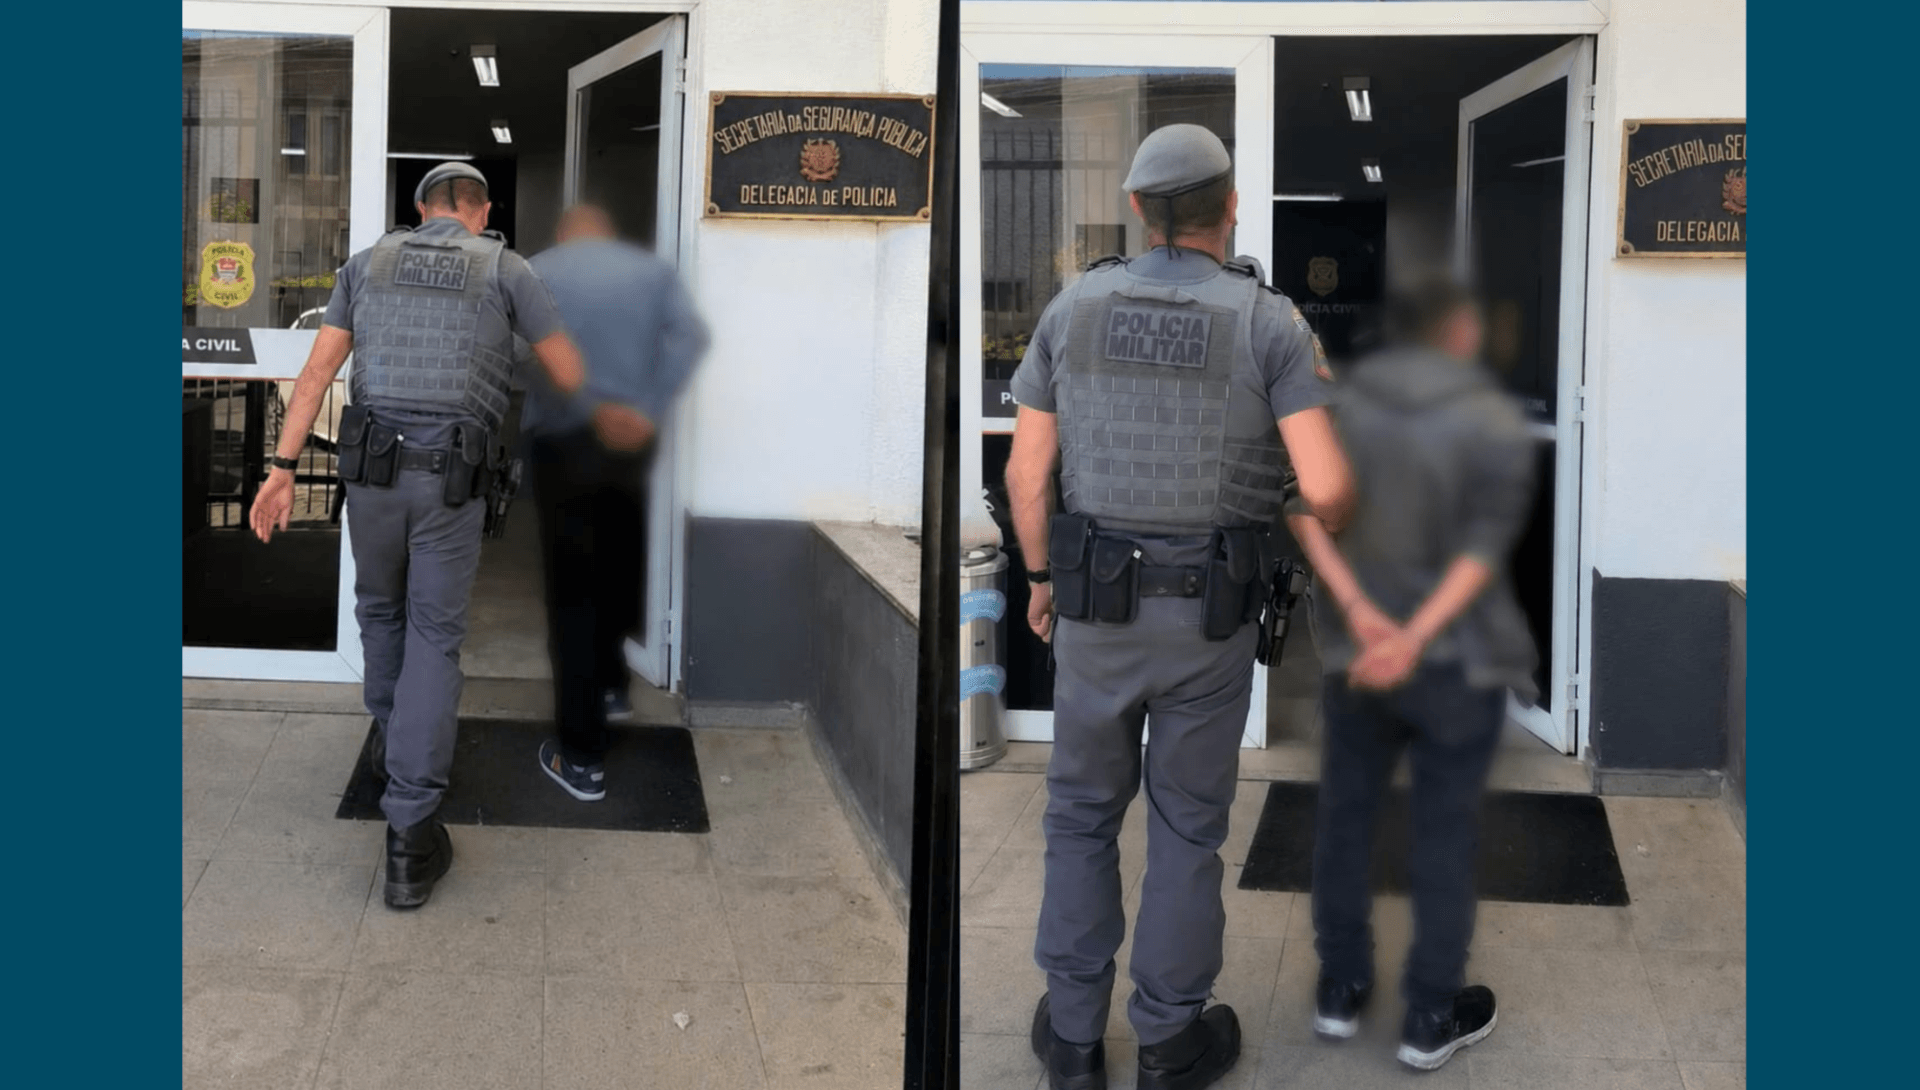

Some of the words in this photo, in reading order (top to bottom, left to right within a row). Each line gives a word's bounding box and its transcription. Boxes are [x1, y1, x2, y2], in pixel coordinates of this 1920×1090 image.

[714, 110, 788, 155] SECRETARIA
[787, 114, 803, 133] DA
[803, 106, 876, 138] SEGURANÇA
[875, 115, 928, 158] PÚBLICA
[1628, 138, 1709, 188] SECRETARIA
[1708, 143, 1725, 163] DA
[740, 185, 817, 205] DELEGACIA
[822, 189, 839, 206] DE
[1657, 221, 1740, 242] DELEGACIA
[397, 267, 463, 288] MILITAR
[1111, 312, 1205, 342] POLÍCIA
[195, 338, 242, 352] CIVIL
[1108, 334, 1204, 365] MILITAR
